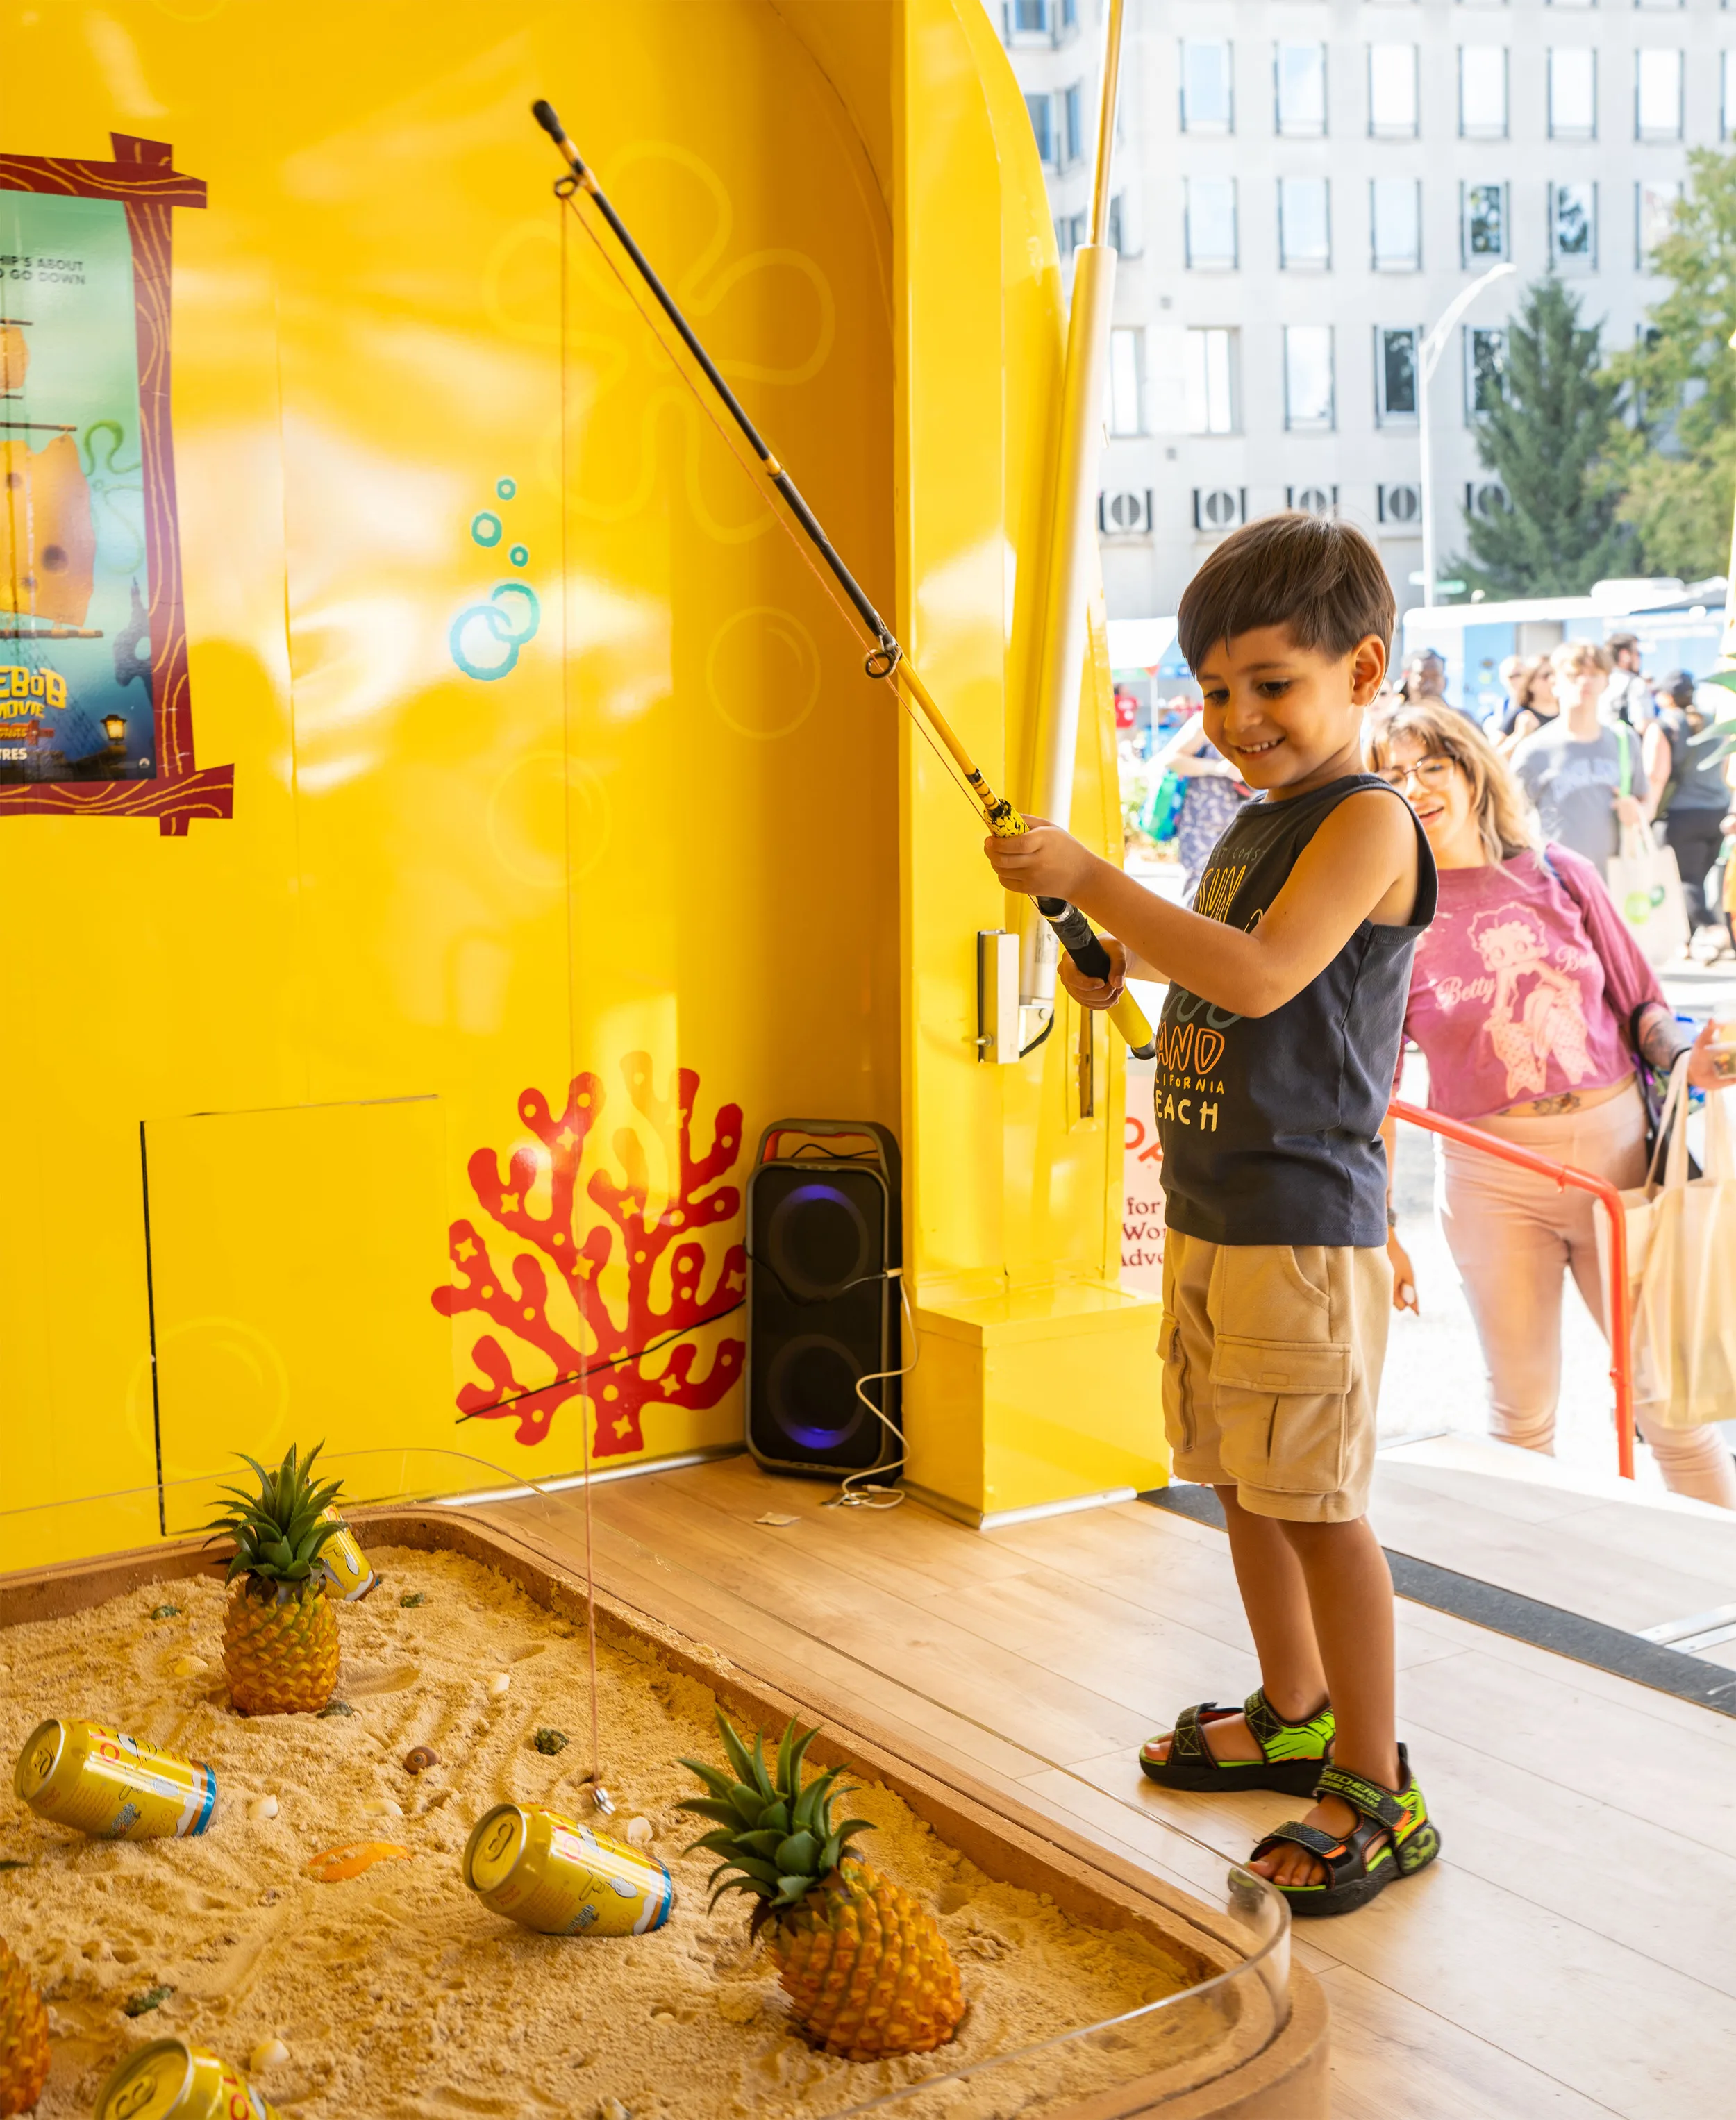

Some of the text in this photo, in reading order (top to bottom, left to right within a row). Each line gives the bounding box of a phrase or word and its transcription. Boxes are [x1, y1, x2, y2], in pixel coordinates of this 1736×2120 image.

[10, 269, 33, 281] GO
[39, 272, 85, 285] DOWN
[37, 258, 83, 272] ABOUT
[1434, 976, 1497, 1010] Betty
[1156, 1020, 1226, 1076] AND
[1155, 1089, 1219, 1132] EACH
[1127, 1196, 1161, 1215] for
